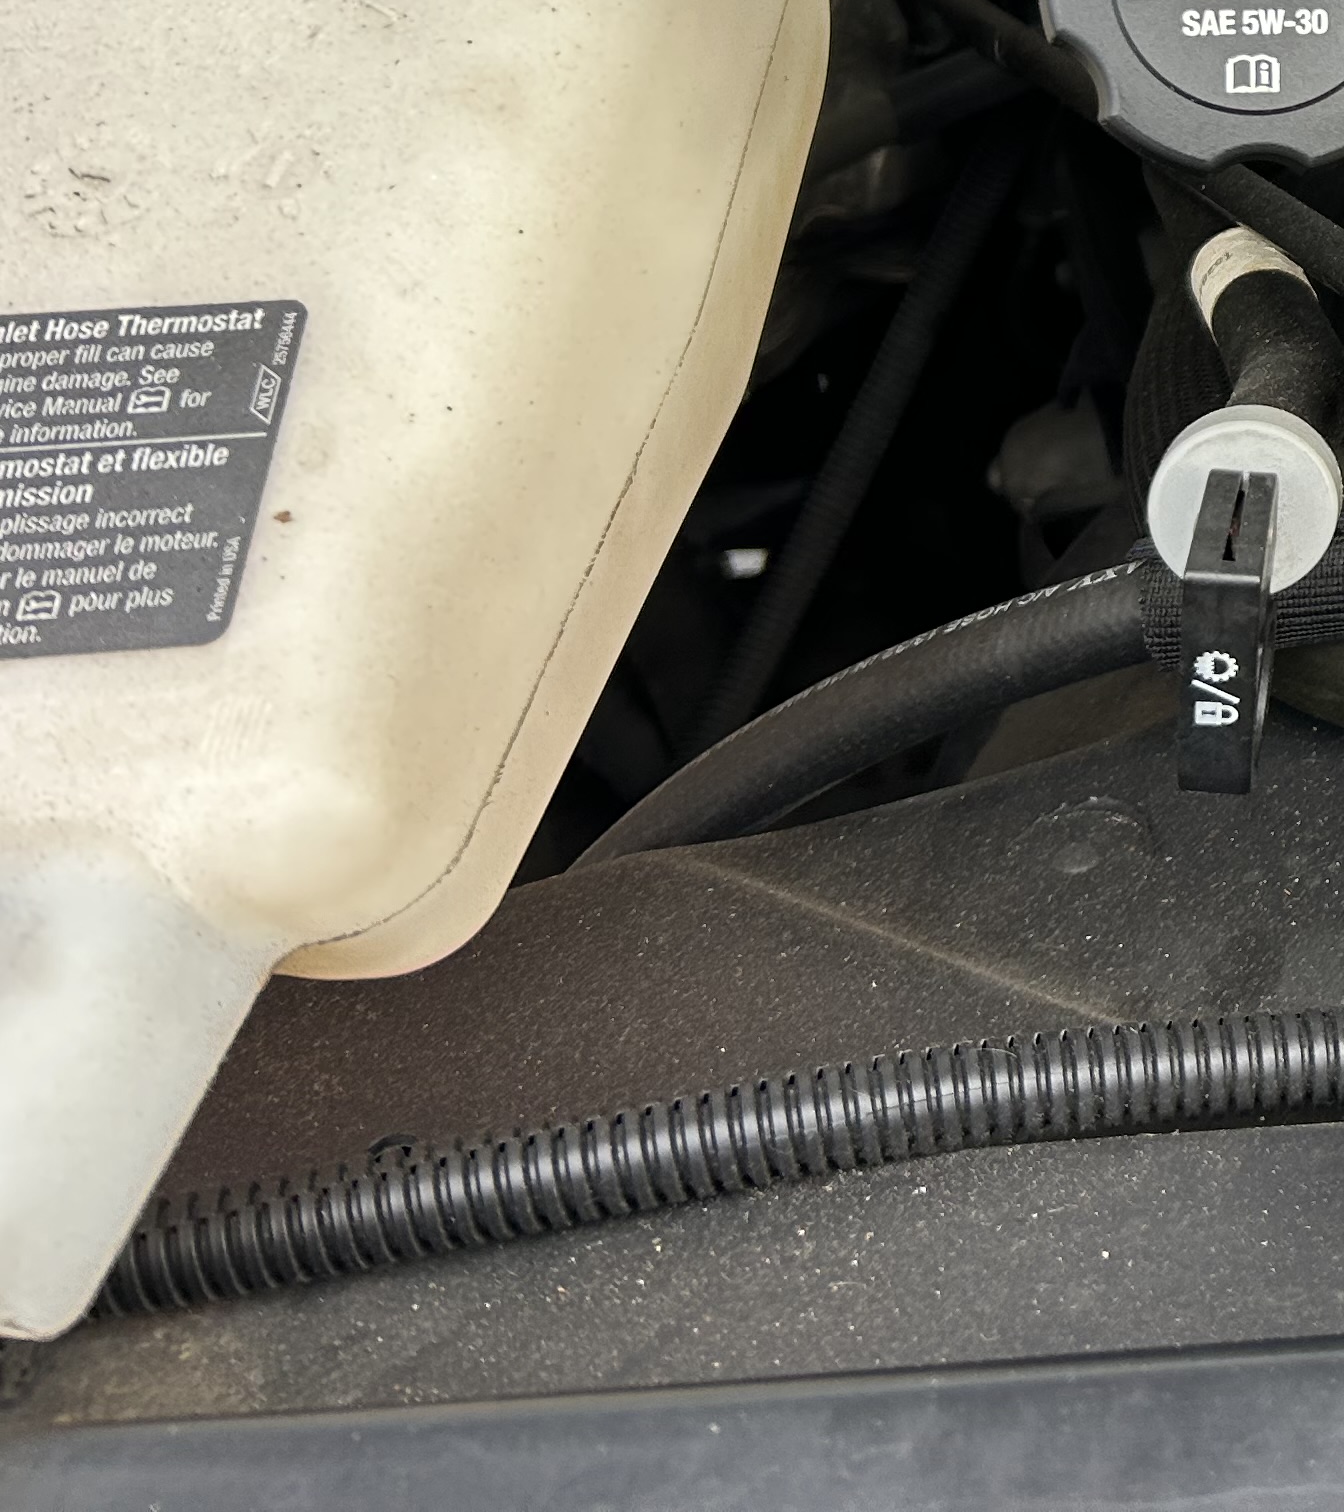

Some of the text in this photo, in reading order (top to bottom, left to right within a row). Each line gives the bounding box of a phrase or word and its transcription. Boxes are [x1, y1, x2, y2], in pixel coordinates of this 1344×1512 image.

[1182, 8, 1329, 36] SAE 5W-30
[44, 318, 110, 341] Hose
[117, 308, 266, 338] Thermostat
[0, 340, 215, 372] proper fill can cause
[42, 368, 132, 392] damage.
[139, 365, 181, 387] See
[256, 377, 277, 410] WLC
[42, 392, 122, 416] Manual
[179, 389, 212, 408] for
[9, 418, 138, 445] information.
[0, 442, 230, 481] mostat et flexible
[0, 502, 195, 538] plissage incorrect
[113, 533, 136, 555] le
[139, 530, 219, 553] moteur.
[15, 566, 37, 588] le
[41, 561, 124, 586] manuel
[129, 559, 158, 581] de
[68, 590, 124, 617] pour
[124, 585, 175, 614] plus
